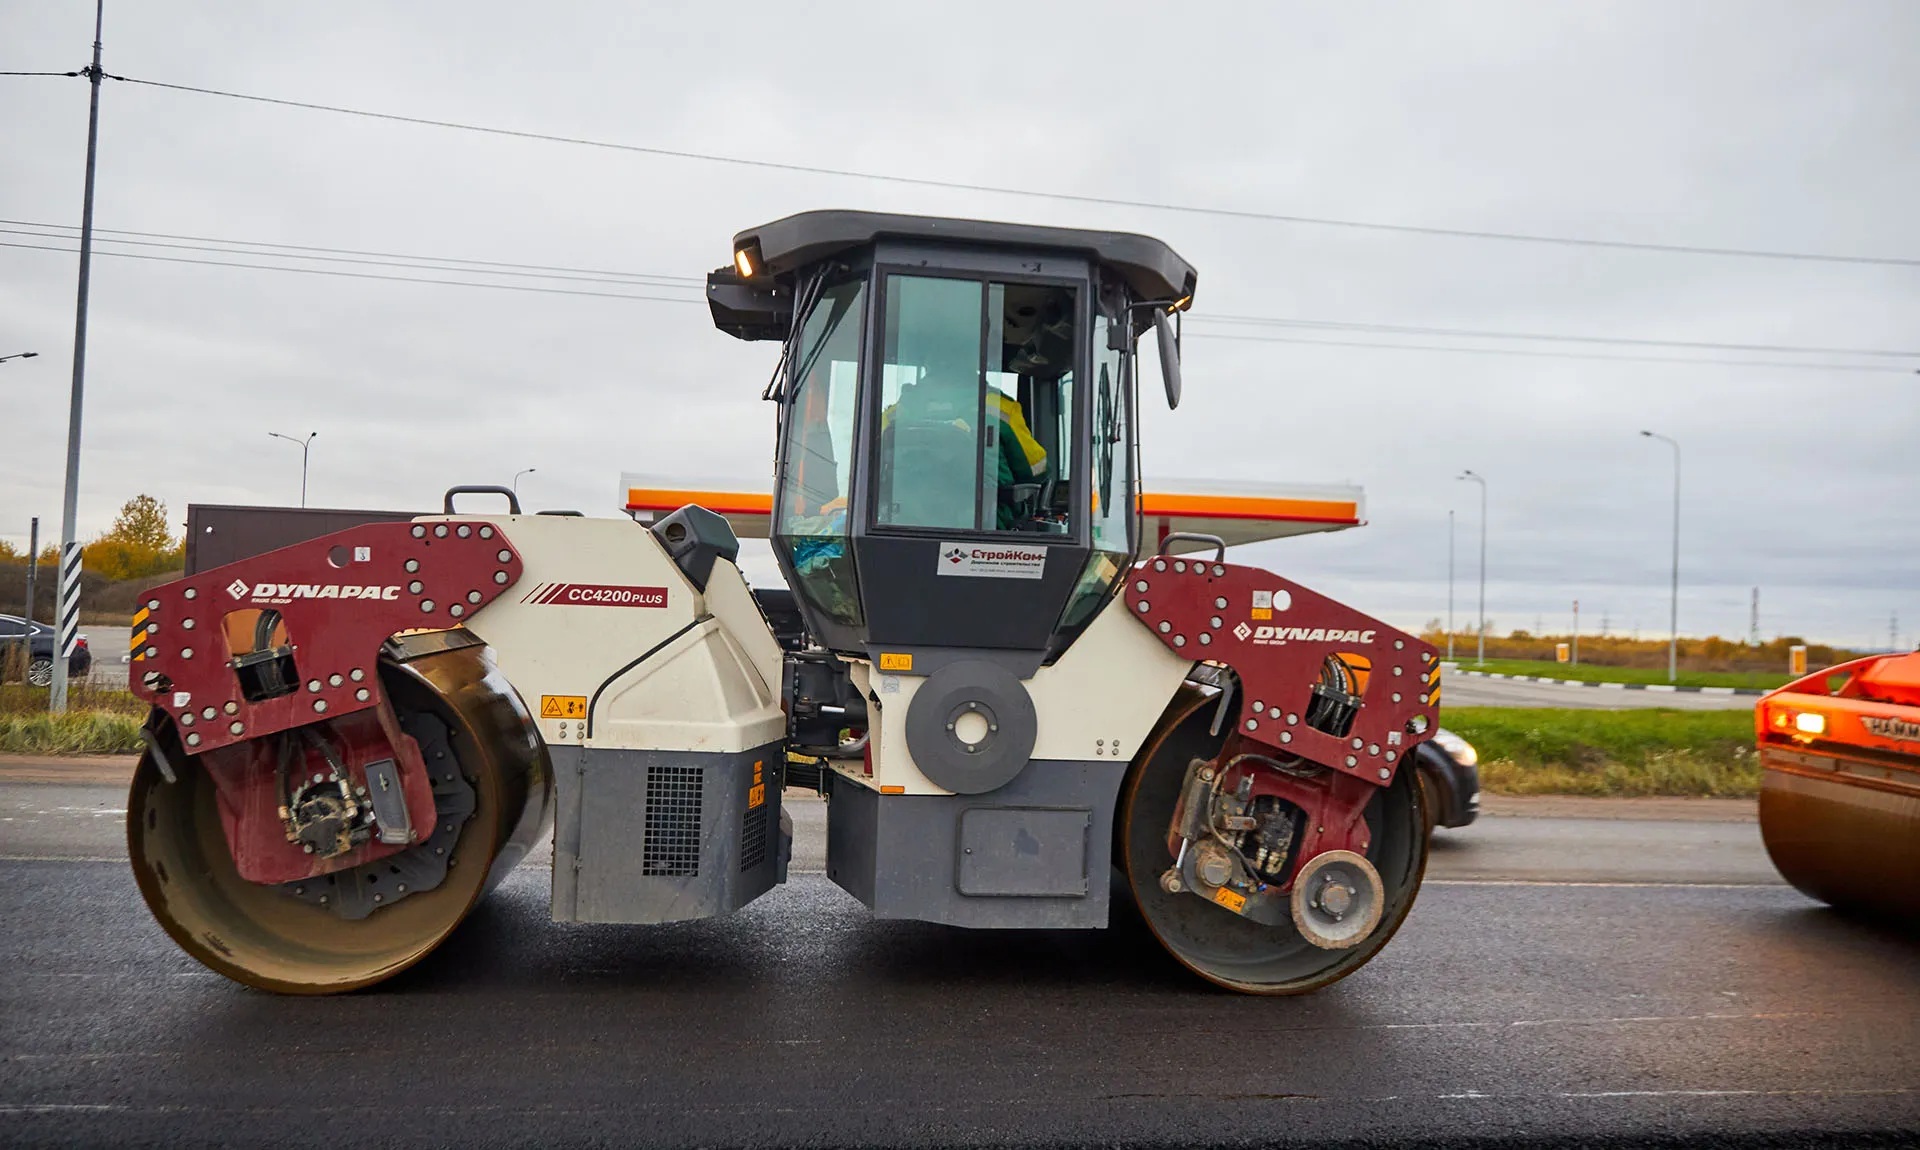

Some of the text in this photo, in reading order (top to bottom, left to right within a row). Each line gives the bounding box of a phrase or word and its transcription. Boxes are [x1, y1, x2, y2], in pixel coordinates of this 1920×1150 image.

[971, 549, 1042, 561] СтройКом
[251, 584, 401, 600] DYNAPAC
[1254, 626, 1376, 643] DYNAPAC
